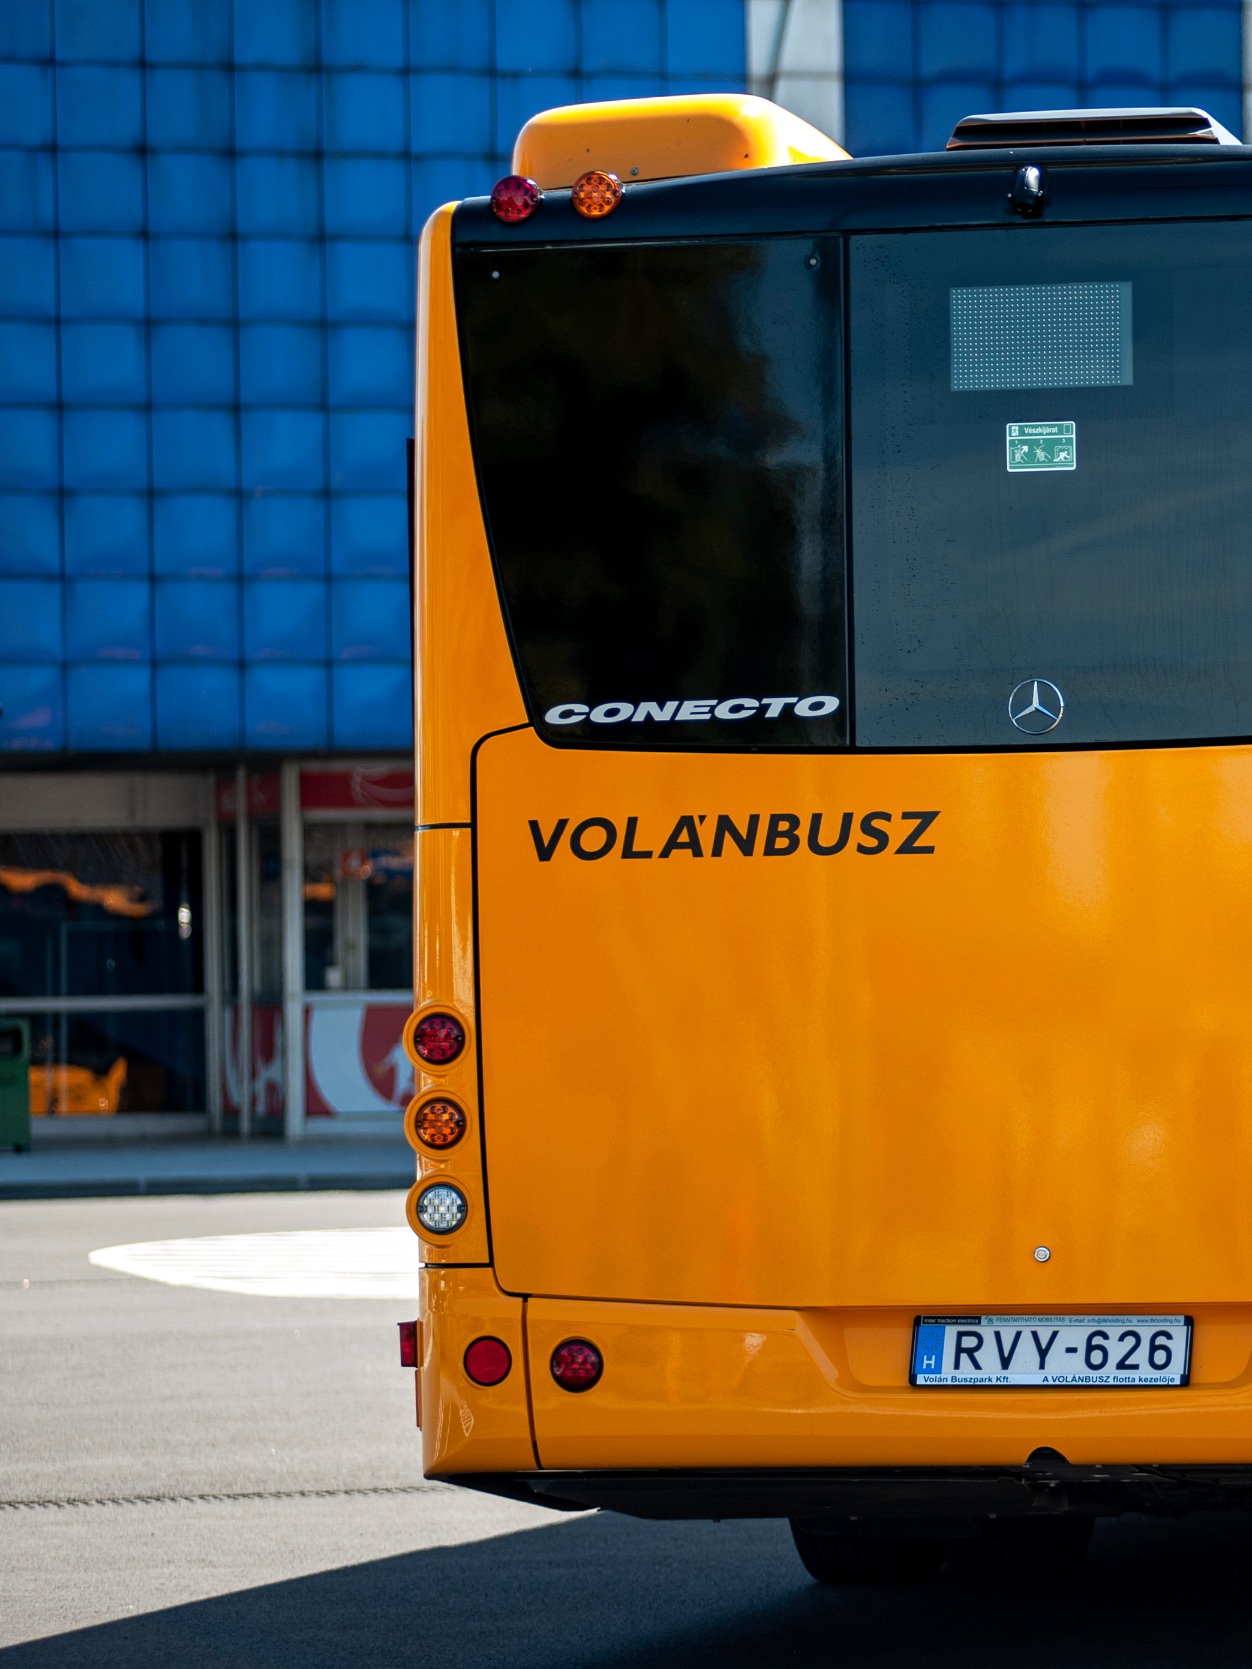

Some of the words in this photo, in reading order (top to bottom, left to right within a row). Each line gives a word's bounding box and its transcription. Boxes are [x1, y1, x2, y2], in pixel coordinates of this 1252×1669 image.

[1024, 426, 1058, 434] Vészkijárat
[544, 695, 840, 725] CONECTO
[528, 810, 941, 862] VOLÁNBUSZ
[953, 1330, 1174, 1371] RVY-626
[922, 1354, 936, 1370] H
[951, 1376, 993, 1384] Buszpark
[995, 1375, 1011, 1383] Kft.
[1052, 1374, 1110, 1383] VOLÁNBUSZ
